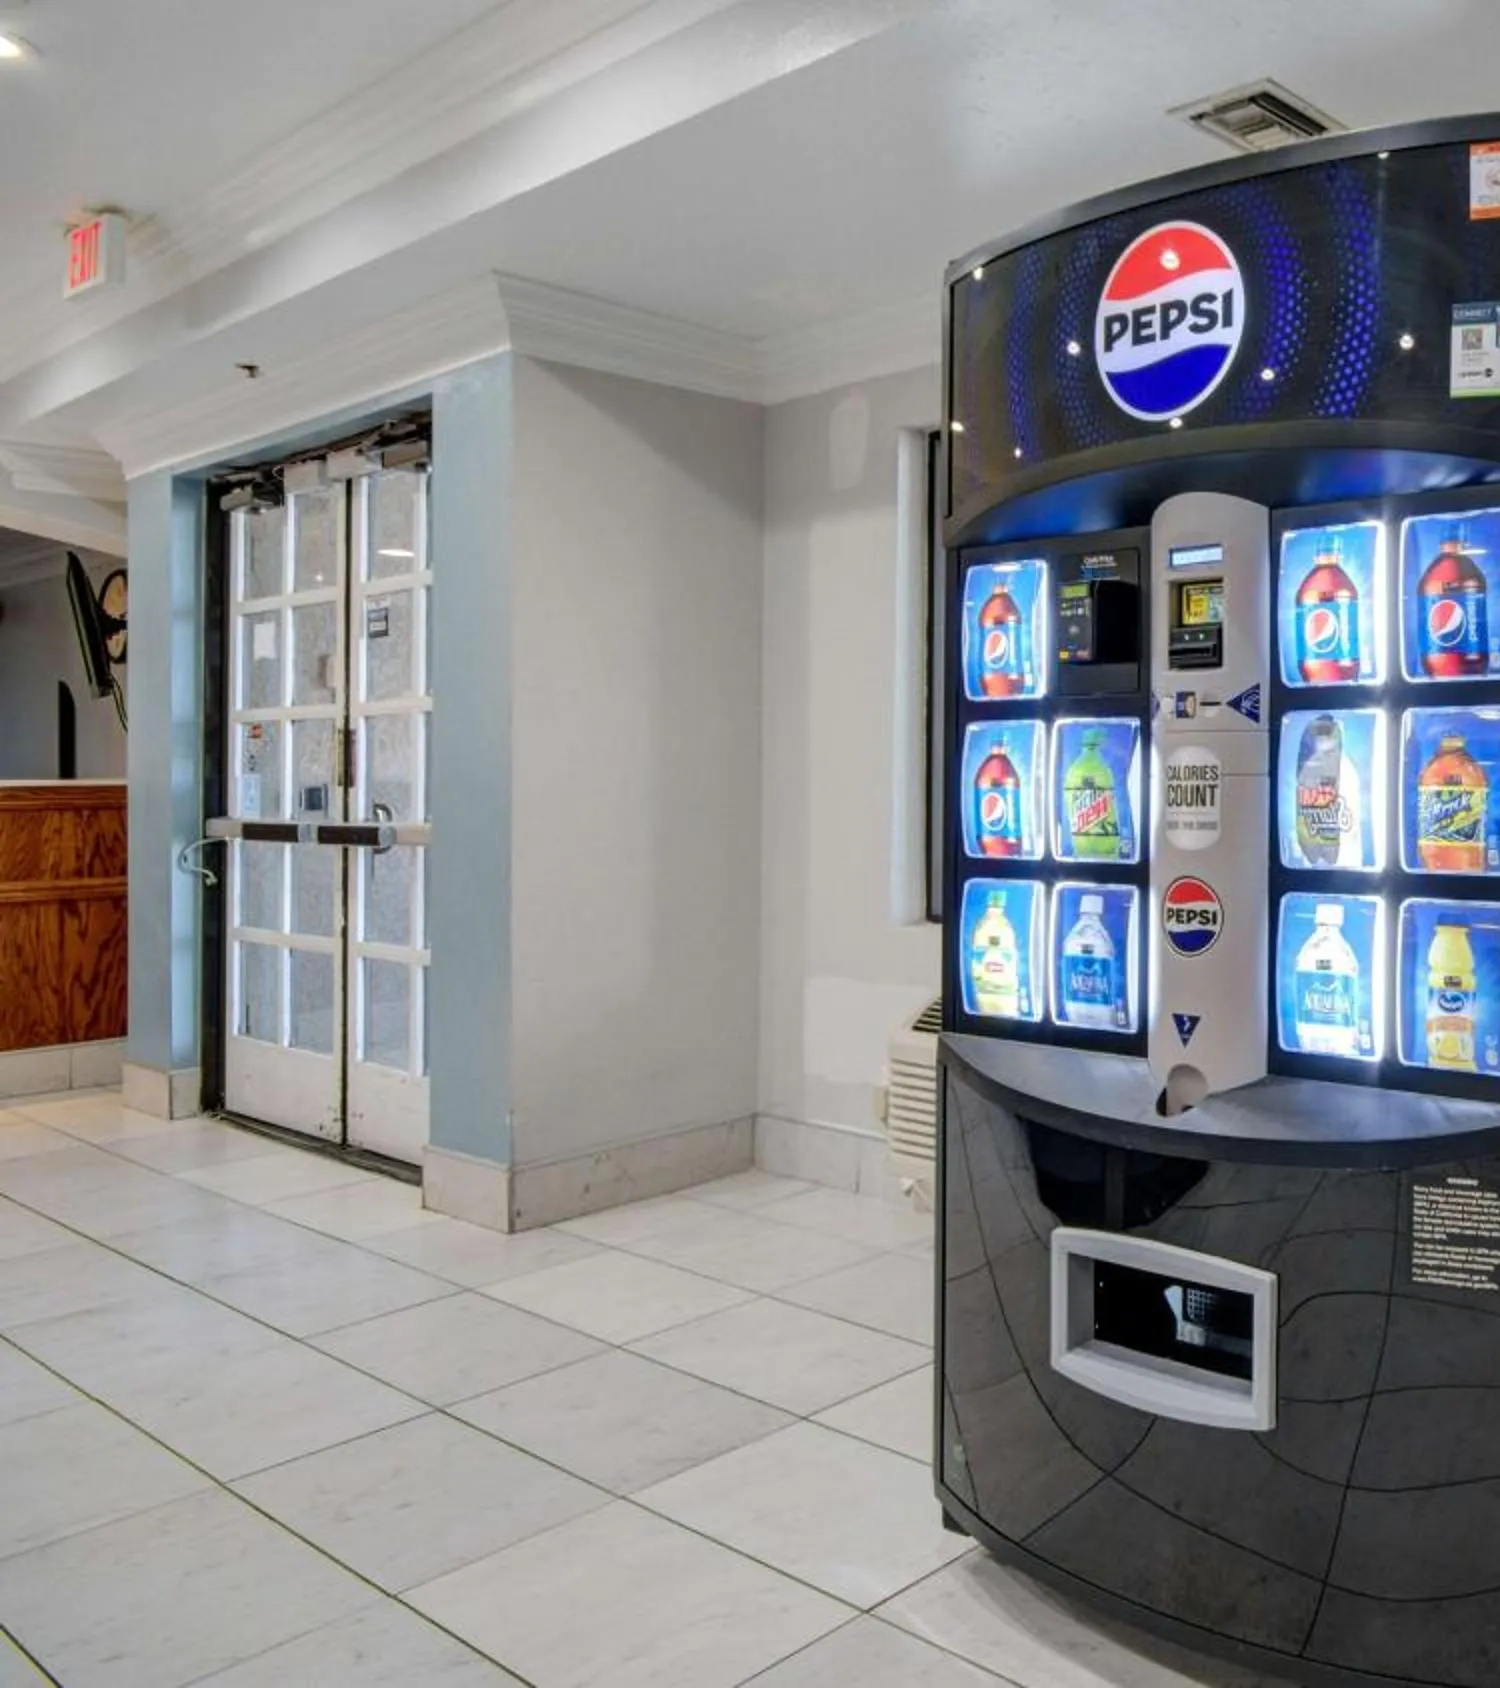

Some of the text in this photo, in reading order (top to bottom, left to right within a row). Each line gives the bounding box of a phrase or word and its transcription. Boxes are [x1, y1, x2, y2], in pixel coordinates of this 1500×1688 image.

[1102, 287, 1235, 354] PEPSI
[1166, 764, 1219, 782] CALORIES
[1166, 783, 1219, 808] COUNT
[1165, 907, 1218, 926] PEPSI
